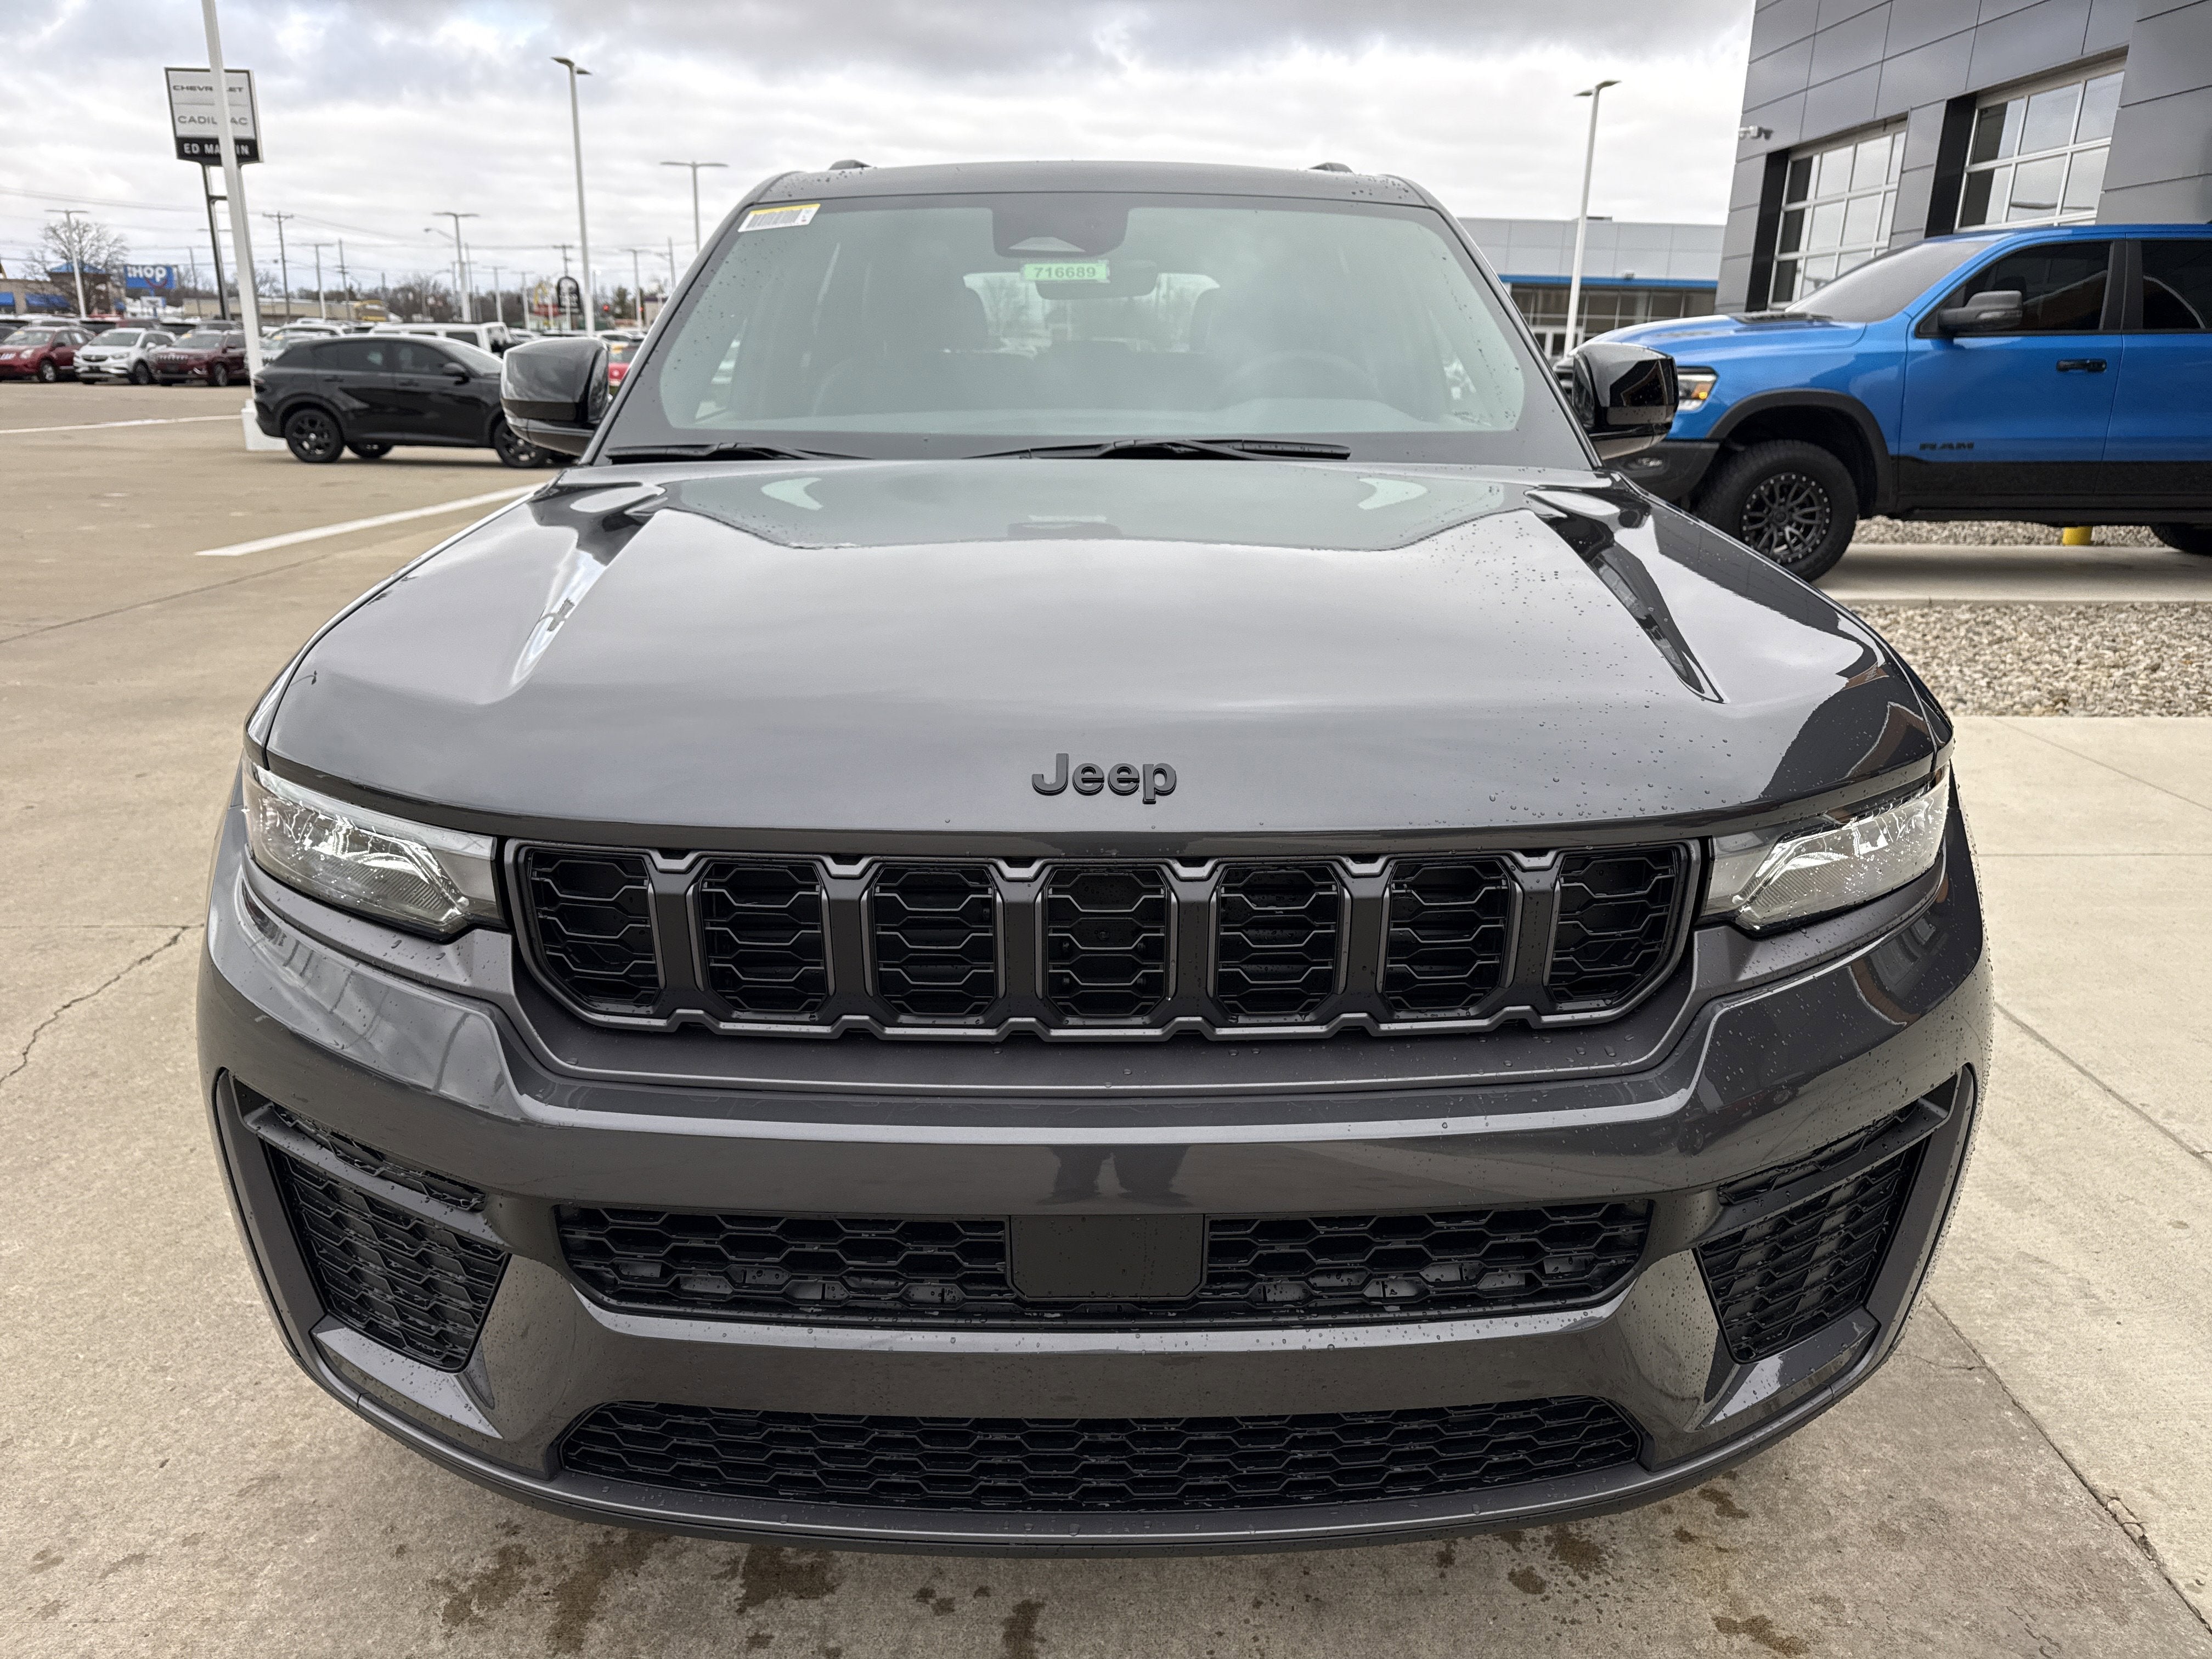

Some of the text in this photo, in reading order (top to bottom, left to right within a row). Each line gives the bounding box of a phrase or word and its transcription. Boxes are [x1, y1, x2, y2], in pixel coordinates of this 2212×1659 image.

[177, 115, 248, 126] CADILAC
[183, 143, 250, 156] ED MAIN
[1034, 266, 1096, 278] 716689
[1919, 442, 1975, 450] RAM
[1031, 753, 1177, 805] Jeep
